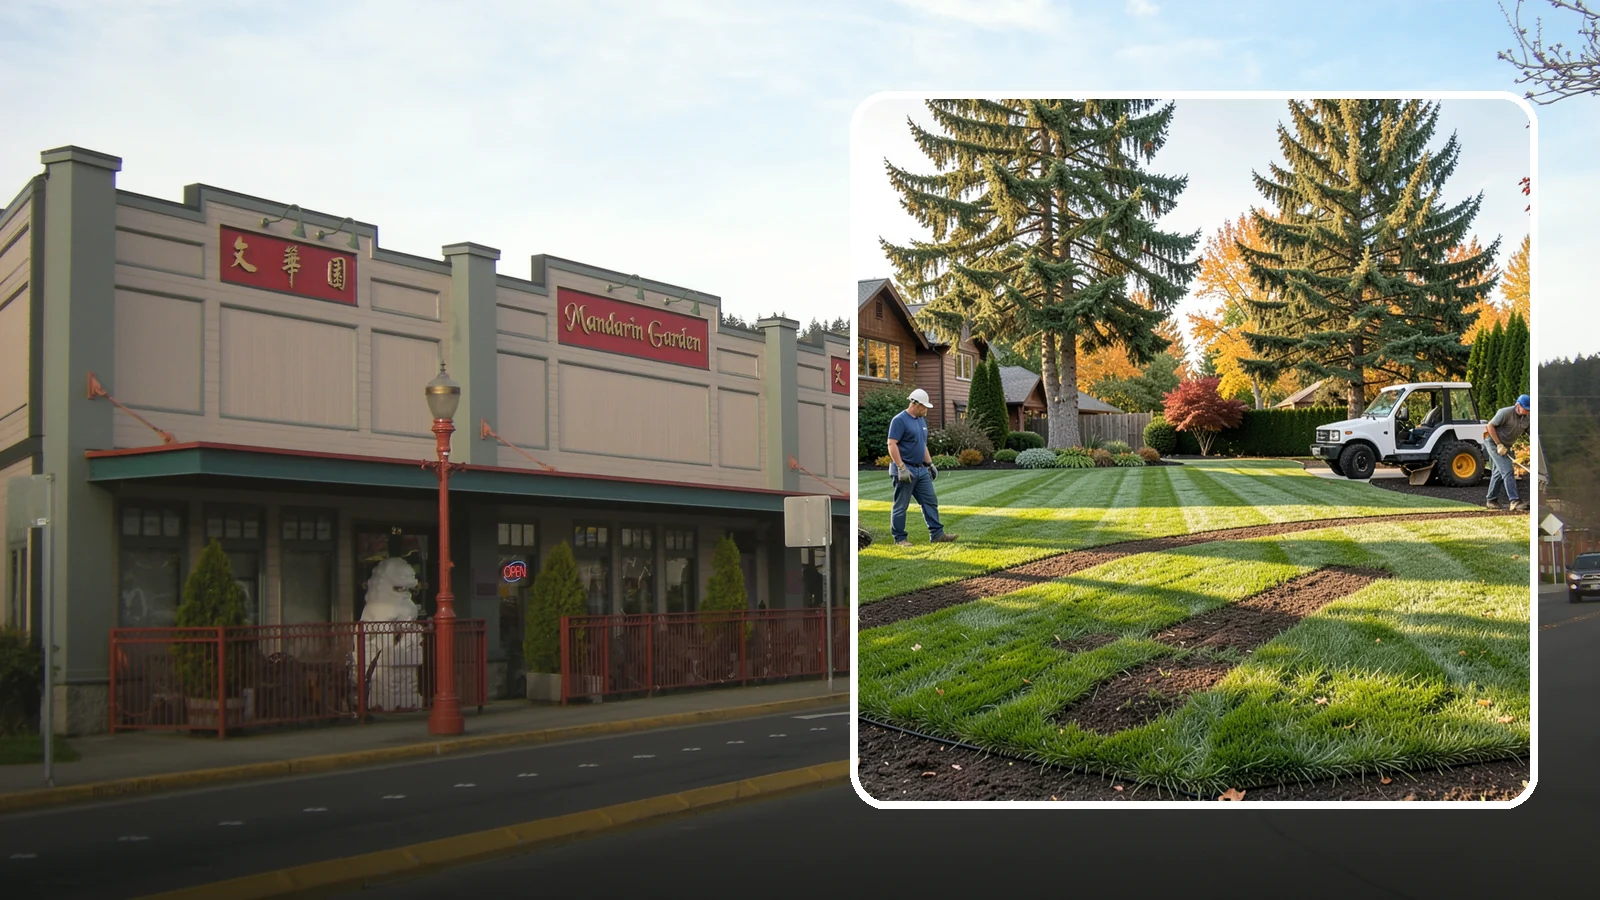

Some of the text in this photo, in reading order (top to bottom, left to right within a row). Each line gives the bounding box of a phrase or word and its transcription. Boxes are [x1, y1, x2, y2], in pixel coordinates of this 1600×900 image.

[231, 235, 346, 291] 文華園
[565, 302, 701, 352] Mandarin Garden
[503, 565, 527, 578] OPEN
